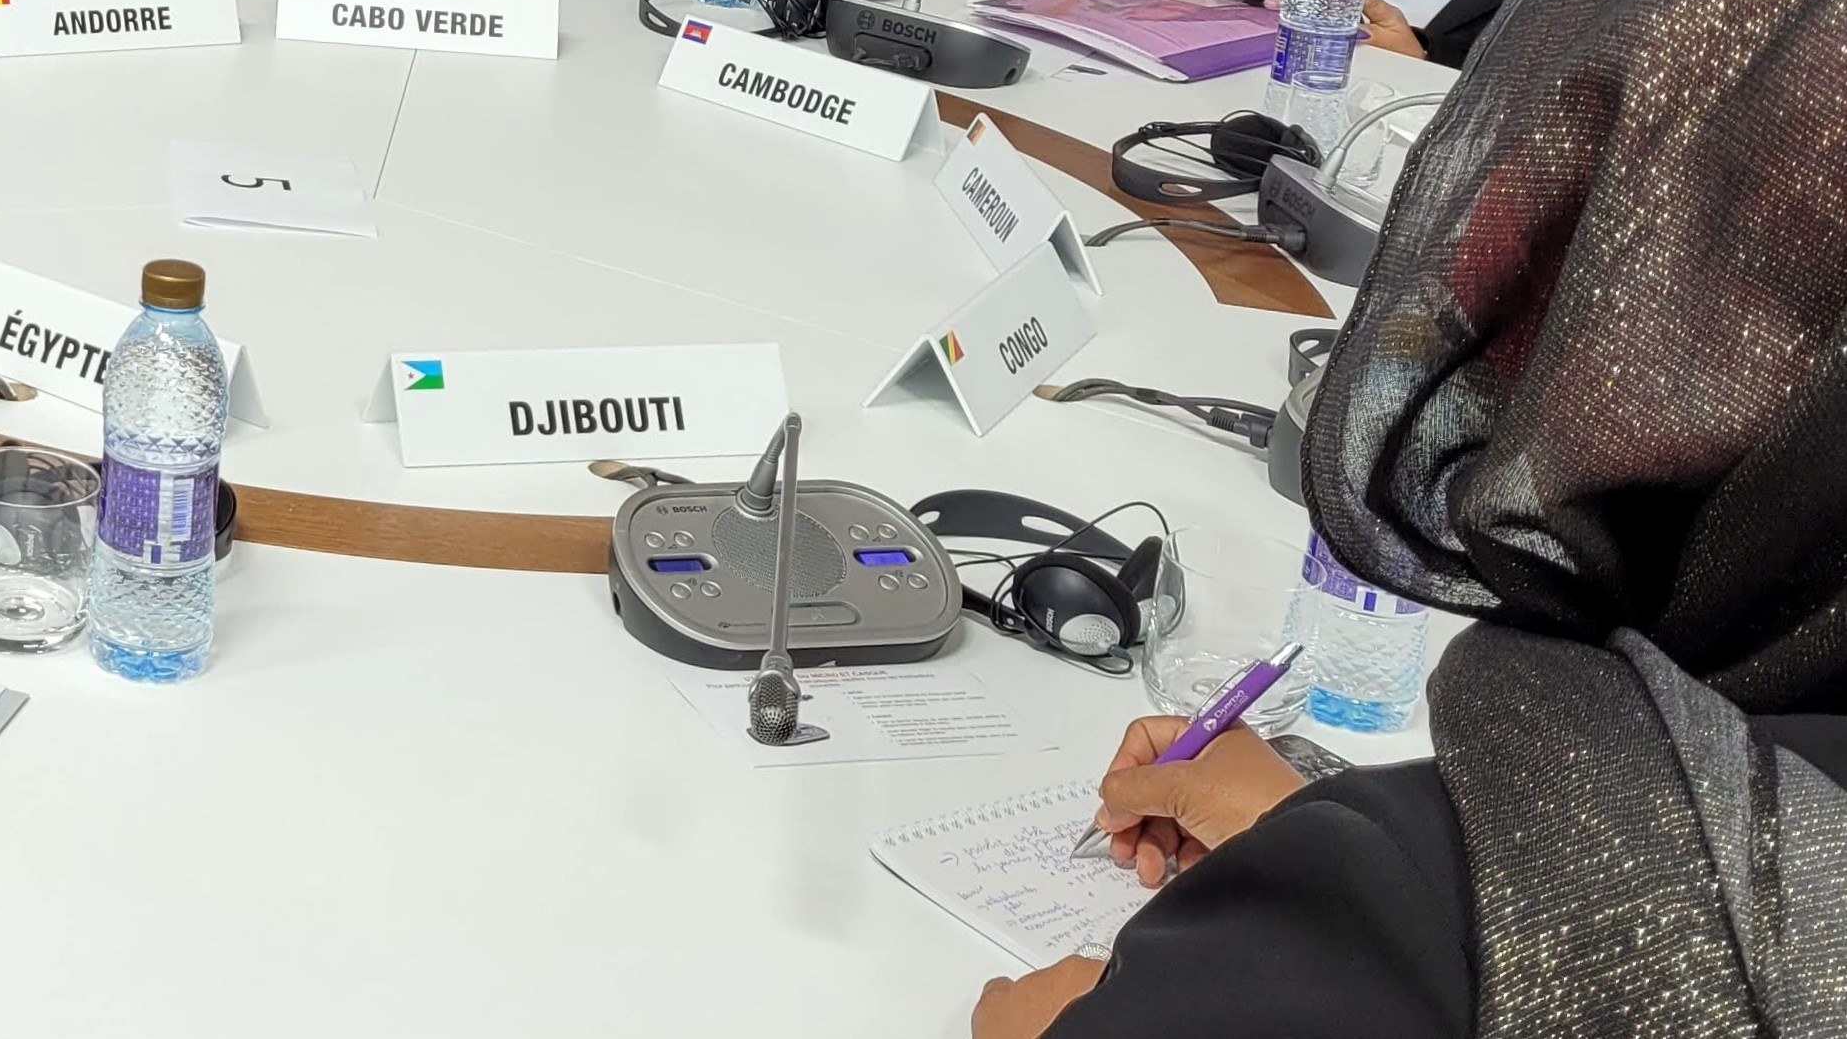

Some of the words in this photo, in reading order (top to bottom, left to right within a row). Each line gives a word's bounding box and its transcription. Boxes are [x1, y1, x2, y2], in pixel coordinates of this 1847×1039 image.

[53, 6, 173, 37] ANDORRE
[332, 2, 405, 30] CABO
[416, 9, 504, 38] VERDE
[882, 19, 938, 45] BOSCH
[718, 62, 856, 126] CAMBODGE
[221, 174, 292, 191] 5
[961, 166, 1020, 244] CAMEROUN
[1282, 187, 1315, 222] BOSCH
[998, 316, 1048, 376] CONGO
[509, 395, 686, 437] DJIBOUTI
[671, 505, 708, 513] BOSCH
